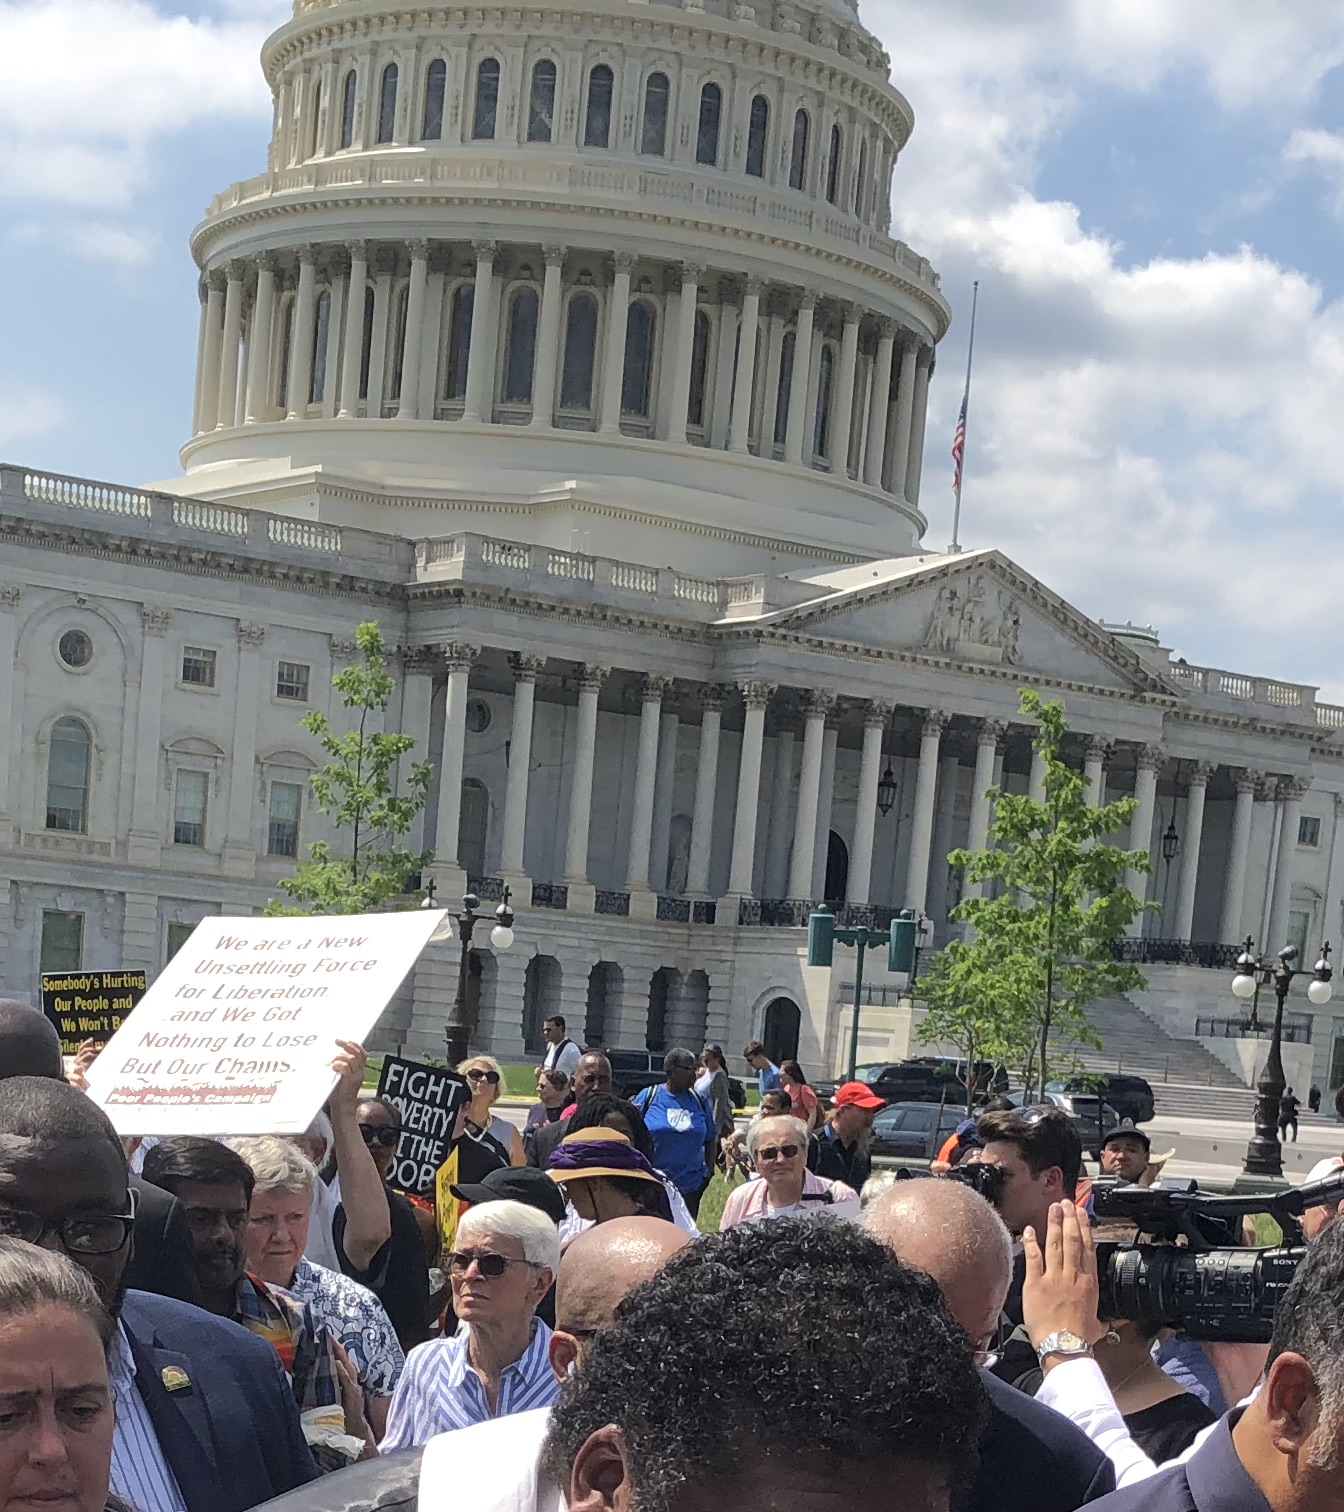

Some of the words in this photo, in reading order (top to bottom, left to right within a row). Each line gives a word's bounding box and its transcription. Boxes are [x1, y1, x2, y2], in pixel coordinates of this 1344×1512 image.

[215, 935, 249, 950] We
[253, 939, 292, 950] are
[297, 938, 312, 950] a
[317, 936, 370, 949] New
[194, 959, 307, 978] Unsettling
[312, 957, 378, 973] Force
[43, 975, 99, 992] Somebody's
[102, 973, 145, 989] Hurting
[174, 984, 207, 999] for
[54, 998, 72, 1012] Our
[75, 995, 109, 1012] People
[112, 994, 133, 1009] and
[222, 1007, 256, 1022] We
[262, 1006, 302, 1021] Got
[61, 1018, 76, 1032] We
[78, 1016, 109, 1031] Won't
[138, 1032, 228, 1052] Nothing
[233, 1032, 256, 1048] to
[262, 1031, 317, 1047] Lose
[120, 1058, 162, 1074] But
[167, 1058, 209, 1075] Our
[384, 1063, 463, 1108] FIGHT
[109, 1094, 142, 1104] Poor
[143, 1094, 201, 1105] People's
[205, 1093, 272, 1105] Campaign
[408, 1133, 444, 1165] THE
